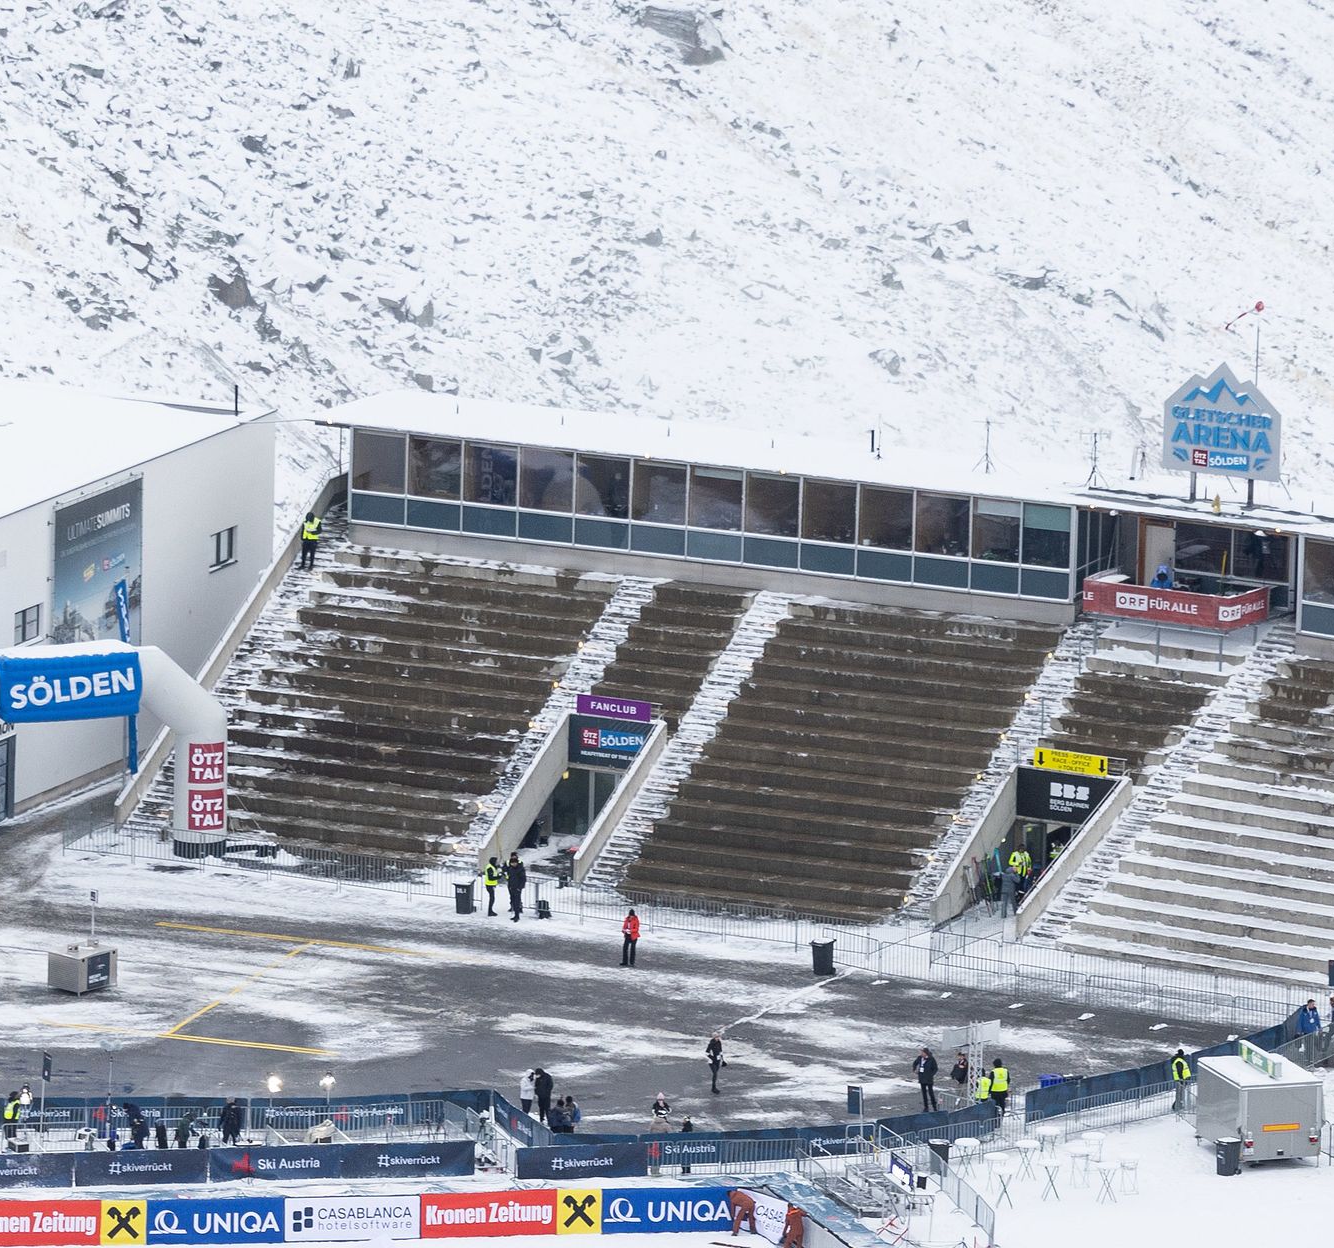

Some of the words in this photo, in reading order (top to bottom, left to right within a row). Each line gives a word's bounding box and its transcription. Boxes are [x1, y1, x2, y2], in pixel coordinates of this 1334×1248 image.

[1171, 404, 1273, 430] GLETSCHER
[1171, 421, 1273, 454] ARENA
[1209, 455, 1247, 466] SÖLDEN
[1119, 595, 1146, 607] ORF
[1149, 595, 1171, 611] FÜR
[1171, 602, 1198, 615] ALLE
[1221, 606, 1240, 618] ORF
[9, 666, 136, 710] SÖLDEN
[590, 701, 637, 715] FANCLUB
[582, 729, 598, 739] ÖTZ
[601, 734, 644, 747] SÖLDEN
[190, 748, 223, 766] ÖTZ
[190, 767, 223, 780] TAL
[190, 794, 223, 812] ÖTZ
[190, 812, 223, 828] TAL
[108, 1161, 173, 1175] #skiverrückt
[257, 1158, 276, 1170] Ski
[279, 1157, 321, 1169] Austria
[376, 1154, 441, 1168] #skiverrückt
[550, 1157, 614, 1171] #skiverrückt
[318, 1206, 413, 1220] CASABLANCA
[425, 1204, 487, 1226] Kronen
[488, 1202, 553, 1225] Zeitung
[648, 1200, 731, 1223] UNIQA
[32, 1211, 97, 1236] Zeitung
[192, 1211, 281, 1234] UNIQA
[318, 1219, 413, 1231] hotelsoftware
